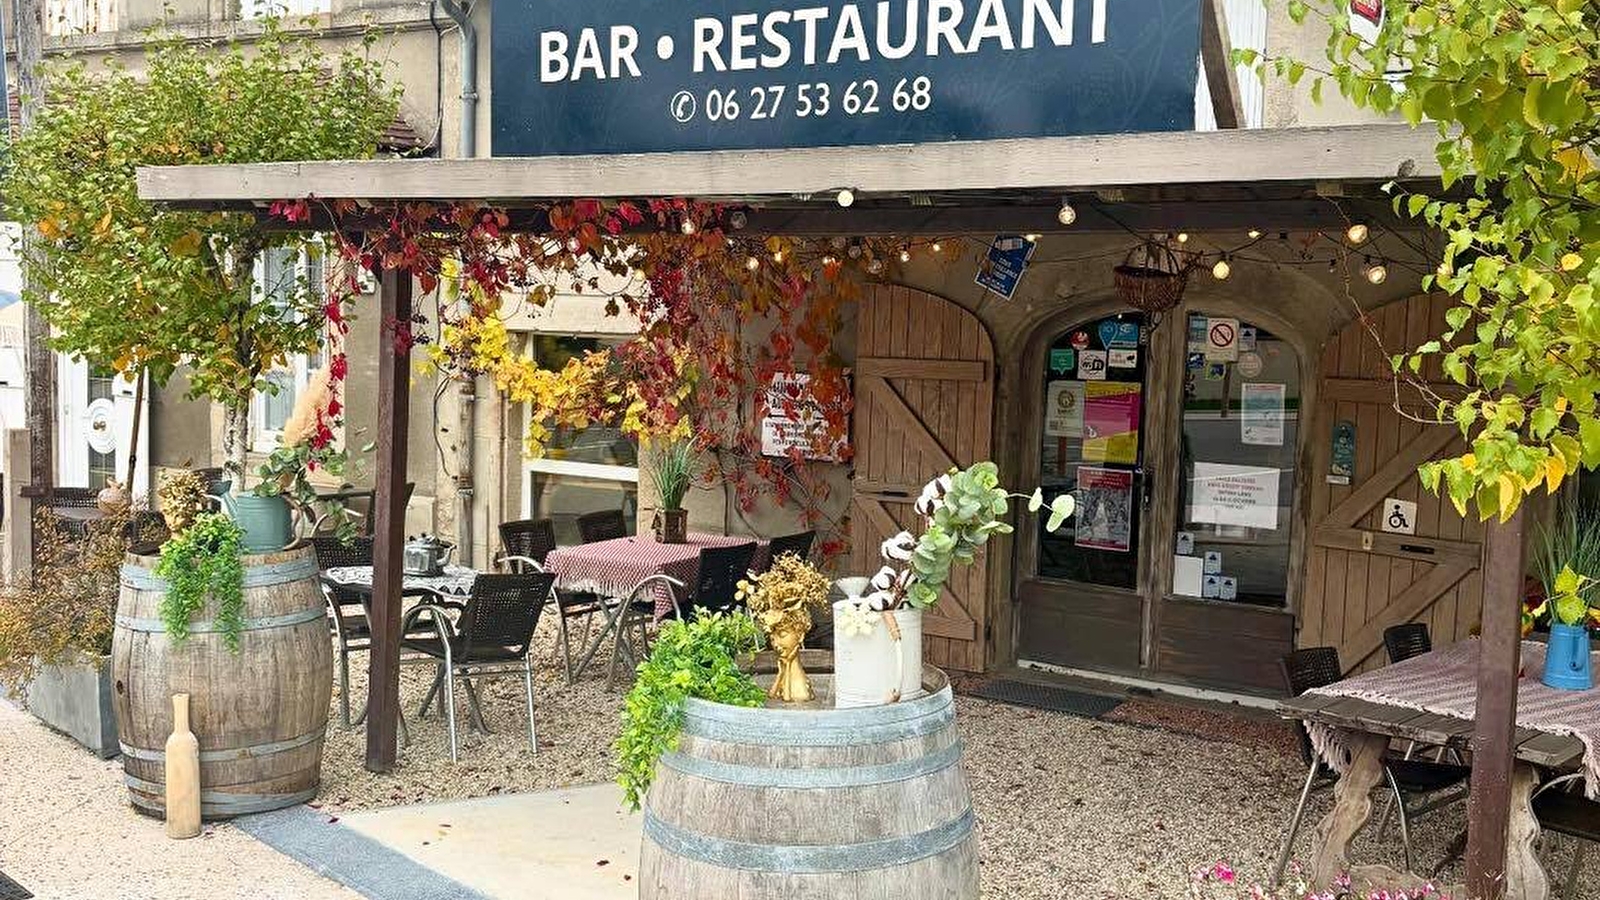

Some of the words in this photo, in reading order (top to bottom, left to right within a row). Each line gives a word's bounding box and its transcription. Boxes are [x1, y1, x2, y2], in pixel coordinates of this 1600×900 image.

[540, 25, 642, 83] BAR
[706, 88, 740, 121] 06
[750, 86, 786, 120] 27
[795, 83, 830, 116] 53
[842, 81, 880, 115] 62
[892, 75, 932, 112] 68
